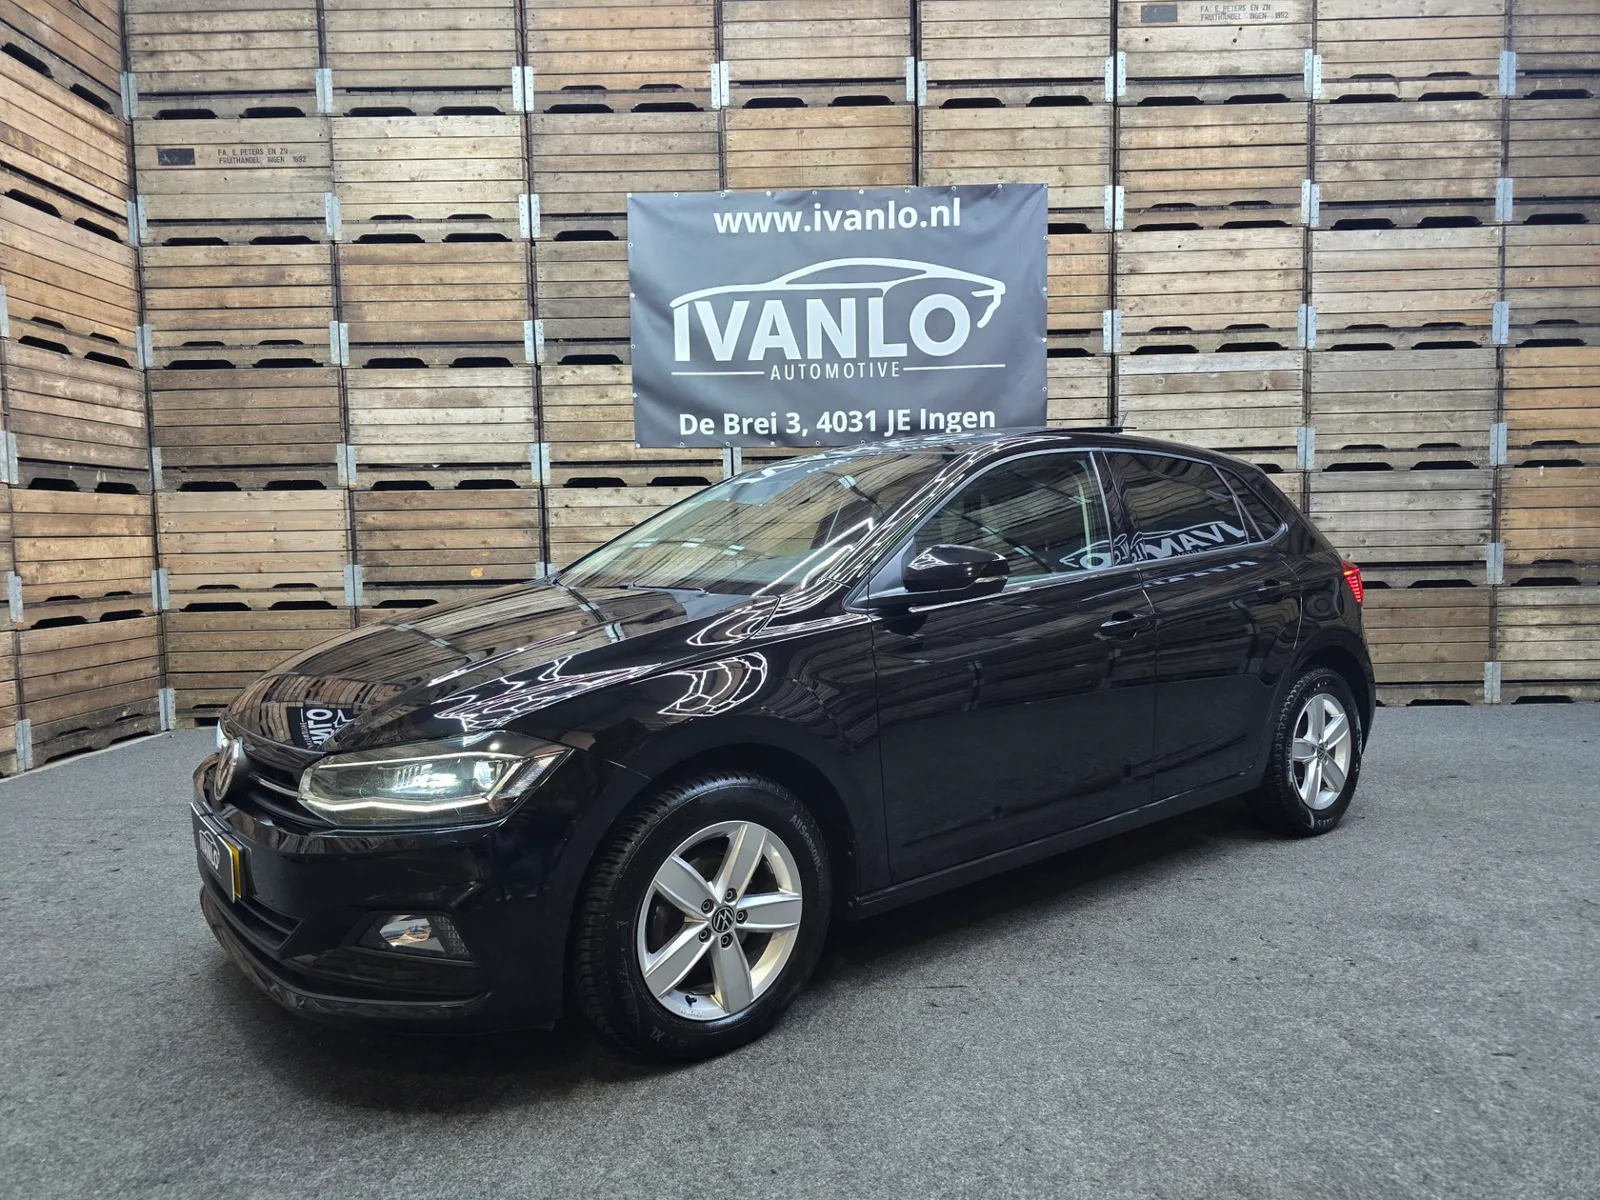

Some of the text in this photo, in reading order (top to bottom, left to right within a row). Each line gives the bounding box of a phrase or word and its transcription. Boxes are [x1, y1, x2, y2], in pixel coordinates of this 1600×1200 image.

[1223, 4, 1246, 12] PETERS
[1250, 3, 1259, 11] EN
[1262, 3, 1271, 11] ZN
[1200, 12, 1242, 21] FRUITHANDEL
[240, 148, 264, 156] PETERS
[219, 156, 260, 164] FRUITHANDEL
[713, 197, 961, 234] www.ivanlo.nl
[673, 293, 971, 362] IVANLO
[770, 361, 900, 381] AUTOMOTIVE
[679, 408, 996, 437] De Brei 3, 4031 JE Ingen
